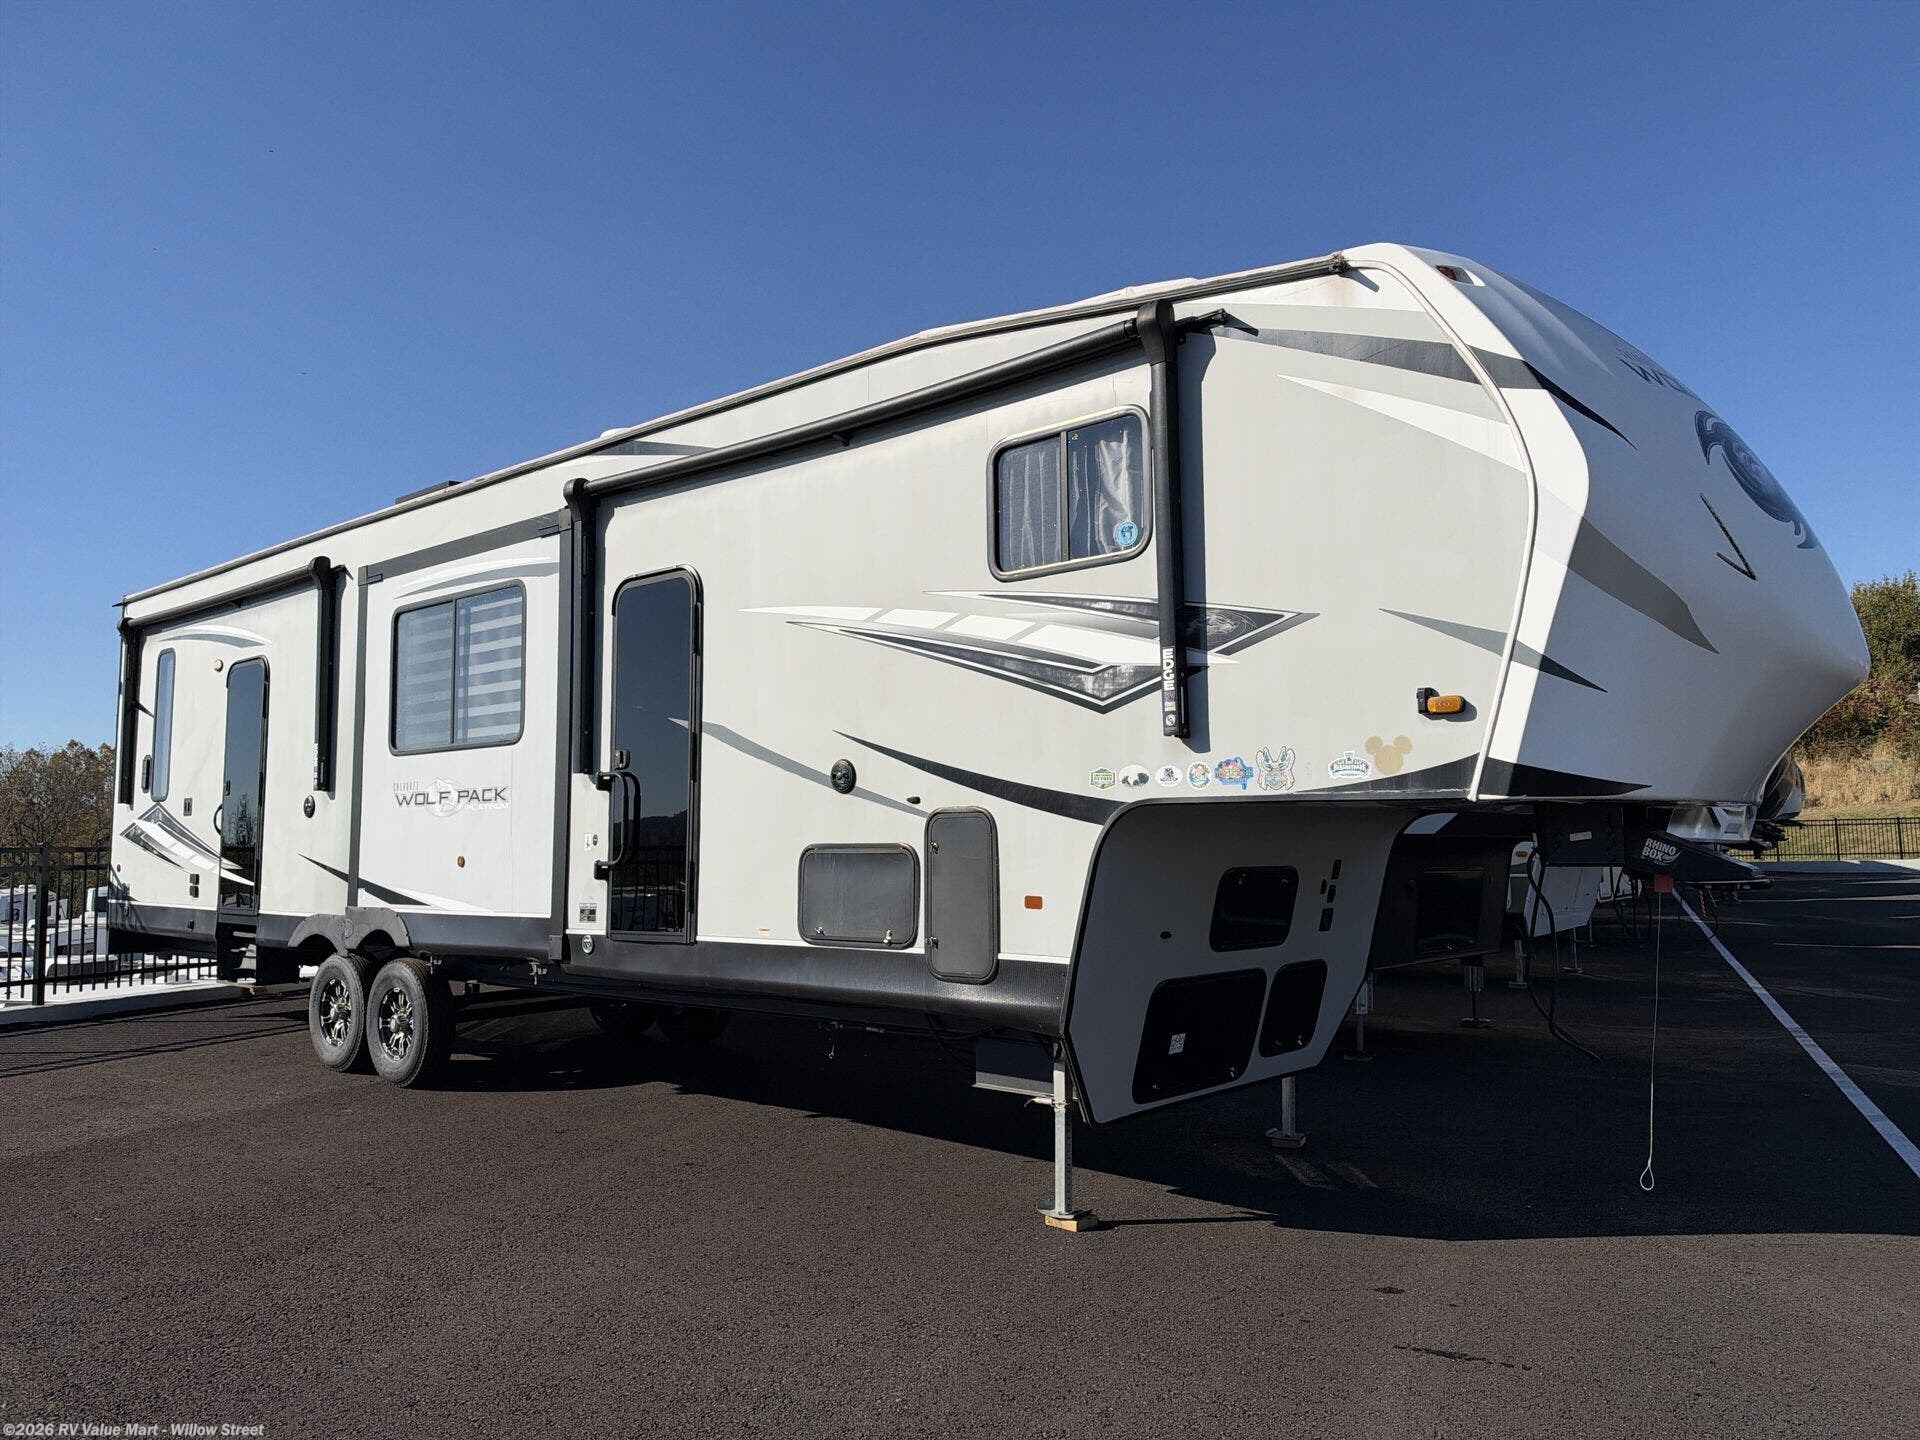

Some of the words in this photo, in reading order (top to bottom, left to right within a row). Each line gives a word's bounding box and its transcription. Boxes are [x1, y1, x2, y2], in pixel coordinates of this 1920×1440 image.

[1162, 648, 1175, 691] EDGE
[395, 791, 450, 806] WOLF
[457, 787, 507, 804] PACK
[1642, 846, 1663, 861] BOX
[1645, 837, 1677, 855] RHINO
